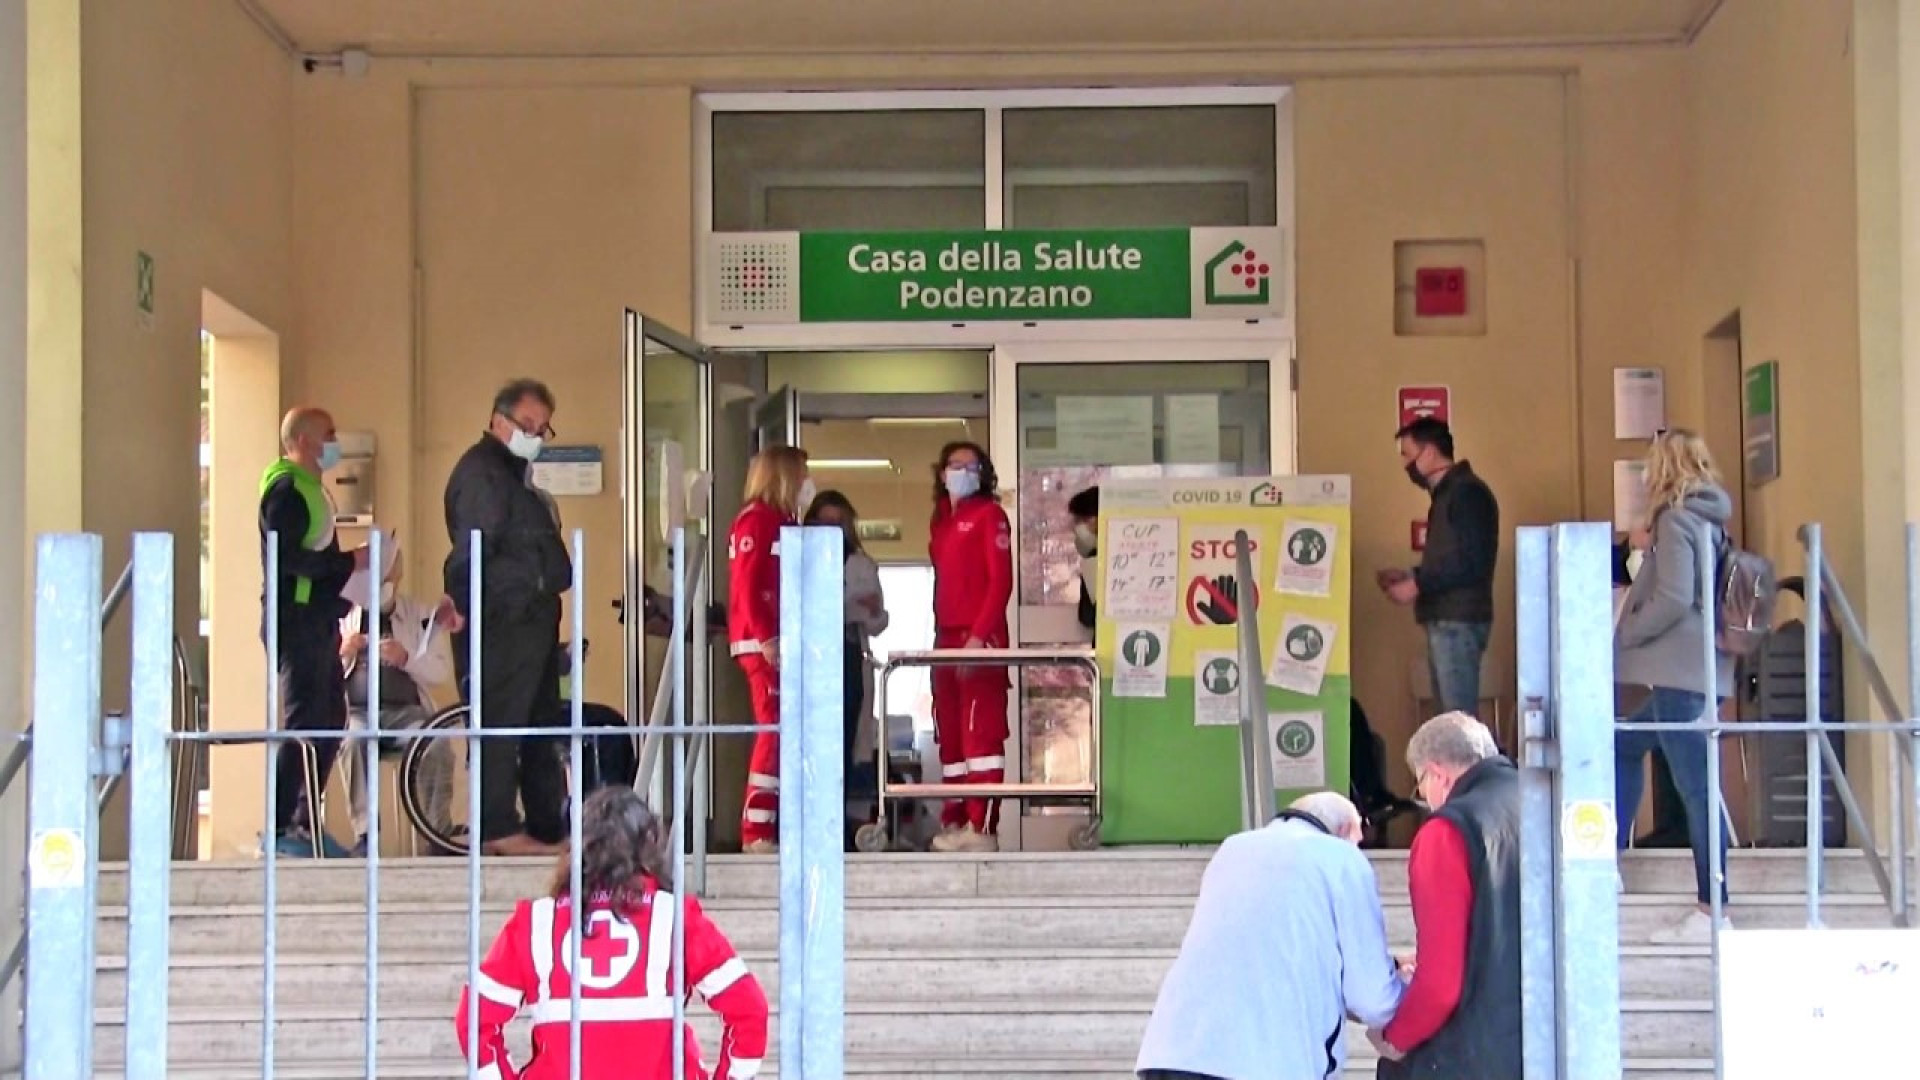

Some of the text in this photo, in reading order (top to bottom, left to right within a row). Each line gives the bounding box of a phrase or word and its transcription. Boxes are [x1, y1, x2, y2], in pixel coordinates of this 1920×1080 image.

[849, 240, 1142, 273] Casa della Salute
[900, 278, 1092, 309] Podenzano
[1172, 490, 1220, 504] COVID
[1224, 489, 1242, 503] 19
